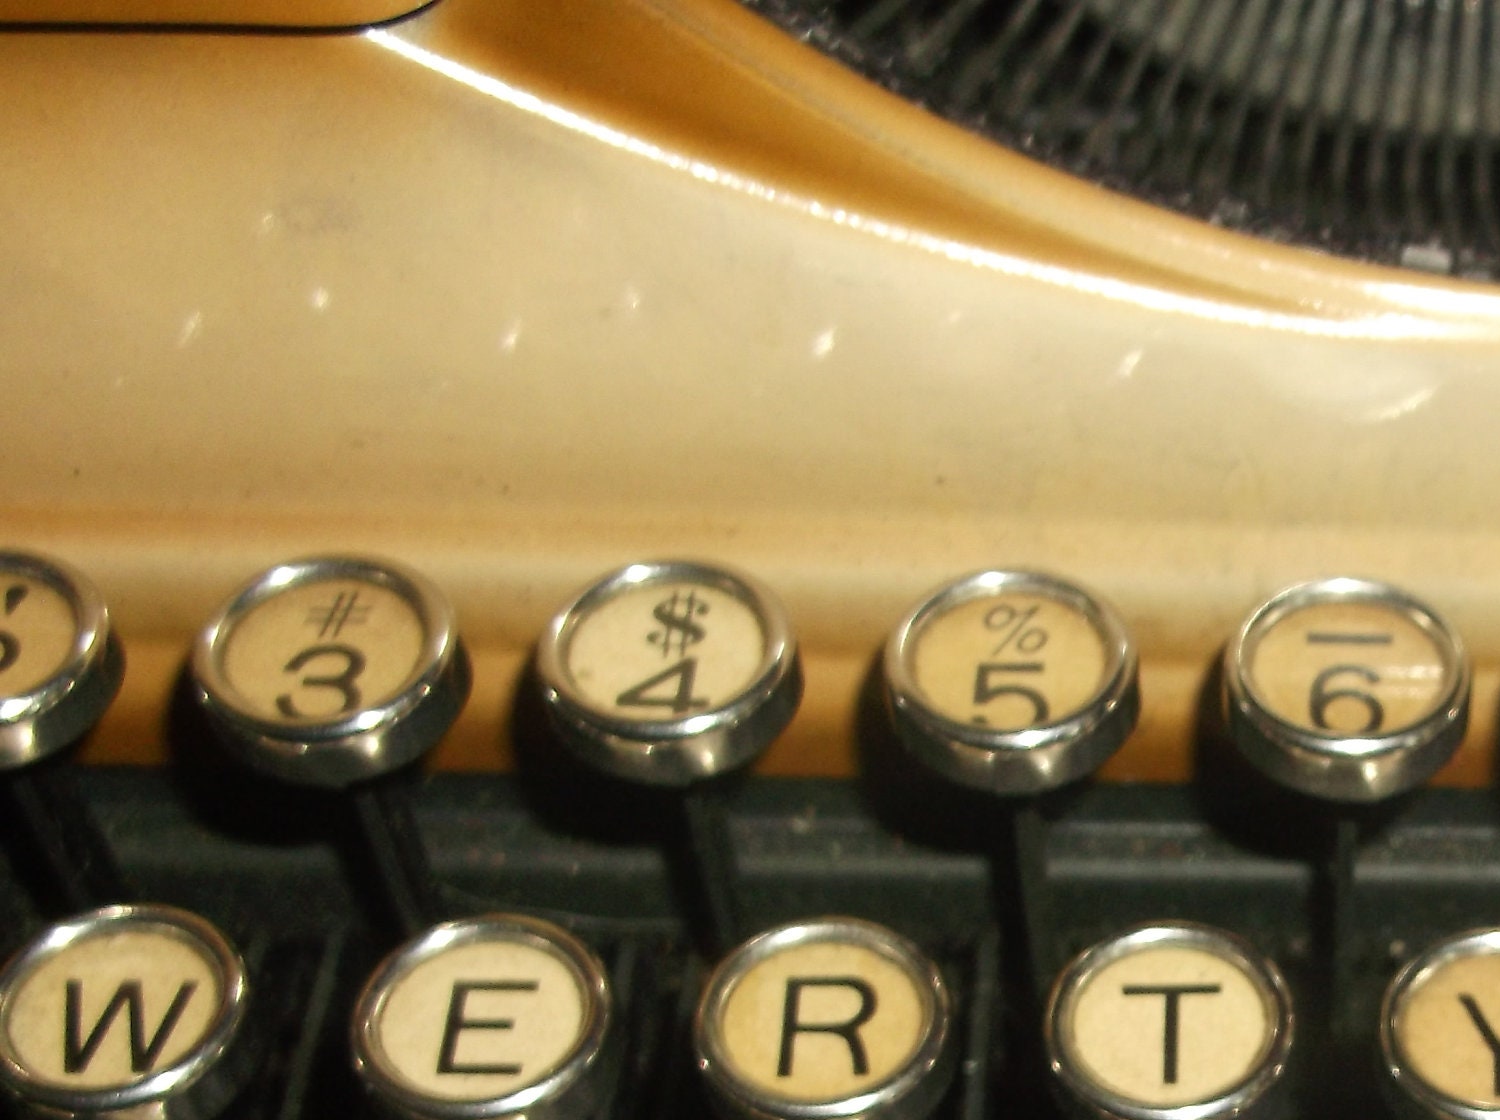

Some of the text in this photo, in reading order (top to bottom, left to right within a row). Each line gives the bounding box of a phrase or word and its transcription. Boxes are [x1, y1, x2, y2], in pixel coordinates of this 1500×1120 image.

[646, 590, 708, 658] $
[984, 604, 1048, 656] %
[275, 642, 366, 718] 3
[615, 657, 710, 715] 4
[971, 662, 1049, 726] 5
[1309, 665, 1384, 738] 6
[64, 980, 196, 1084] W
[436, 981, 538, 1076] E
[777, 977, 878, 1077] R
[1122, 984, 1221, 1085] T
